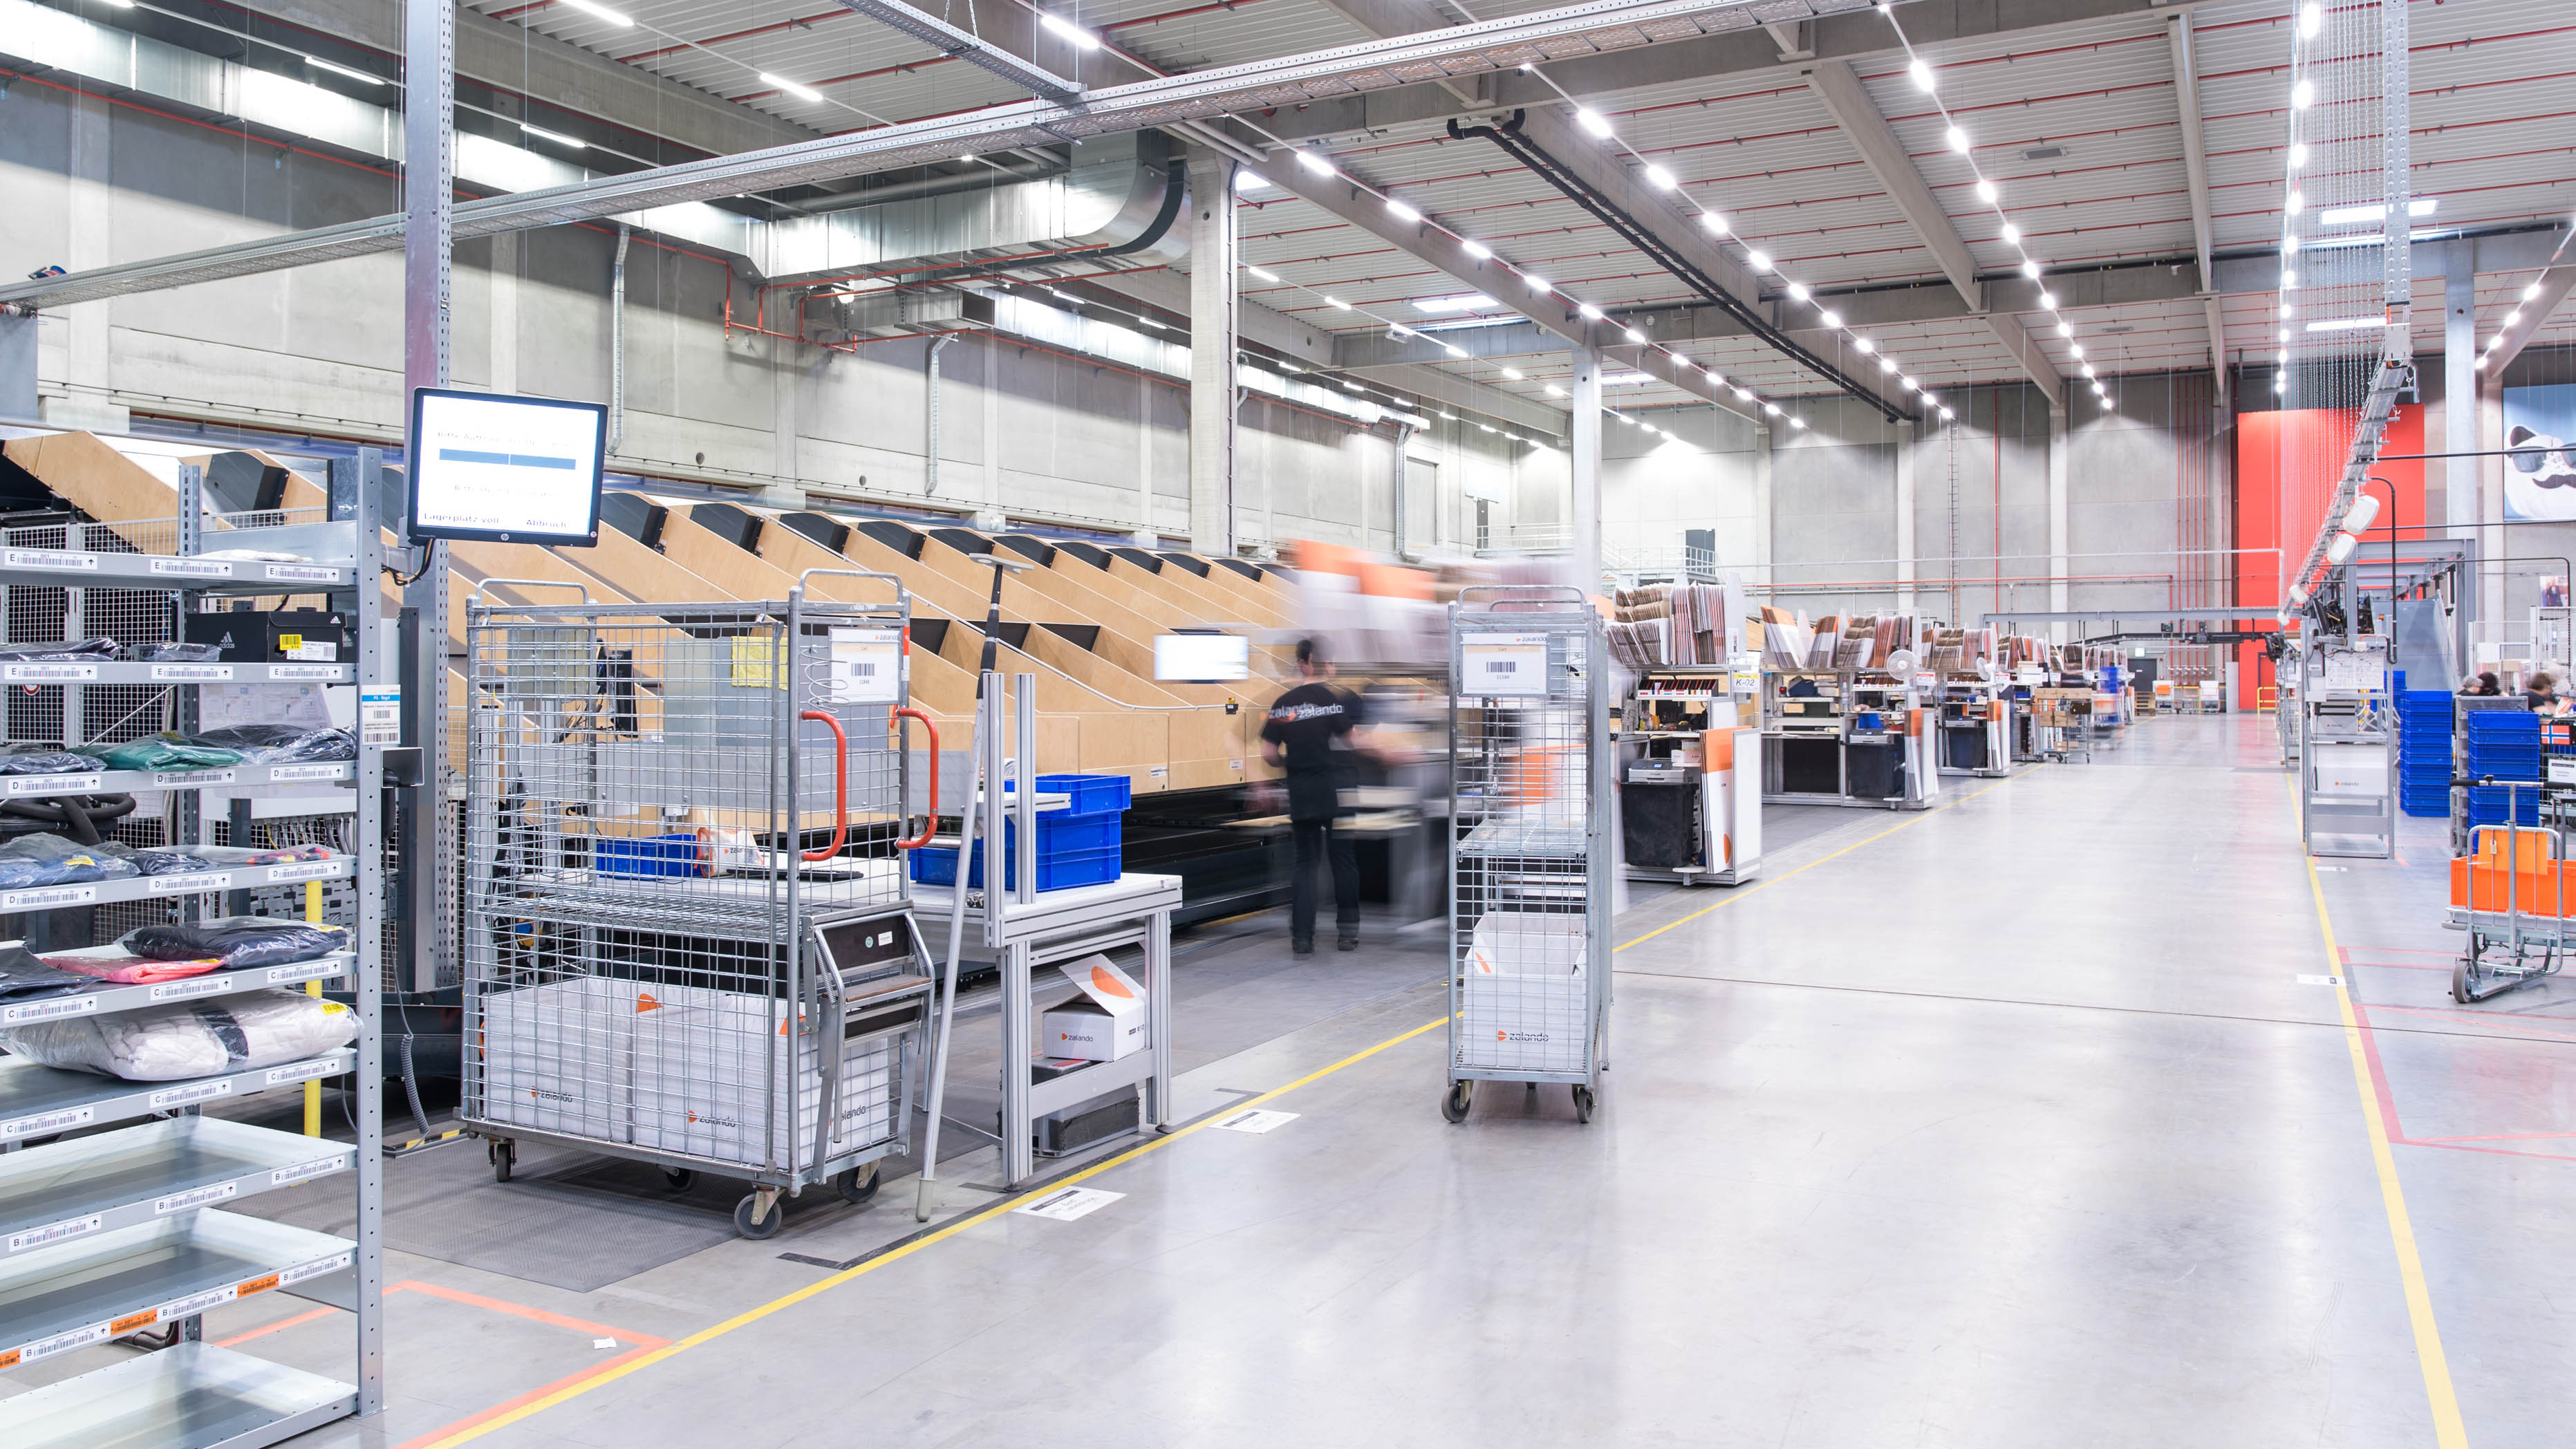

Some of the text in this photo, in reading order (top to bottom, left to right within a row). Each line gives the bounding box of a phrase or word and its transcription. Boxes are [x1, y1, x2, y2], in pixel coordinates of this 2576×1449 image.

[1298, 703, 1343, 718] zalando
[1068, 1034, 1094, 1043] zalando
[1509, 1031, 1549, 1042] zalando
[541, 1090, 573, 1103] zalando
[841, 1105, 866, 1121] alando
